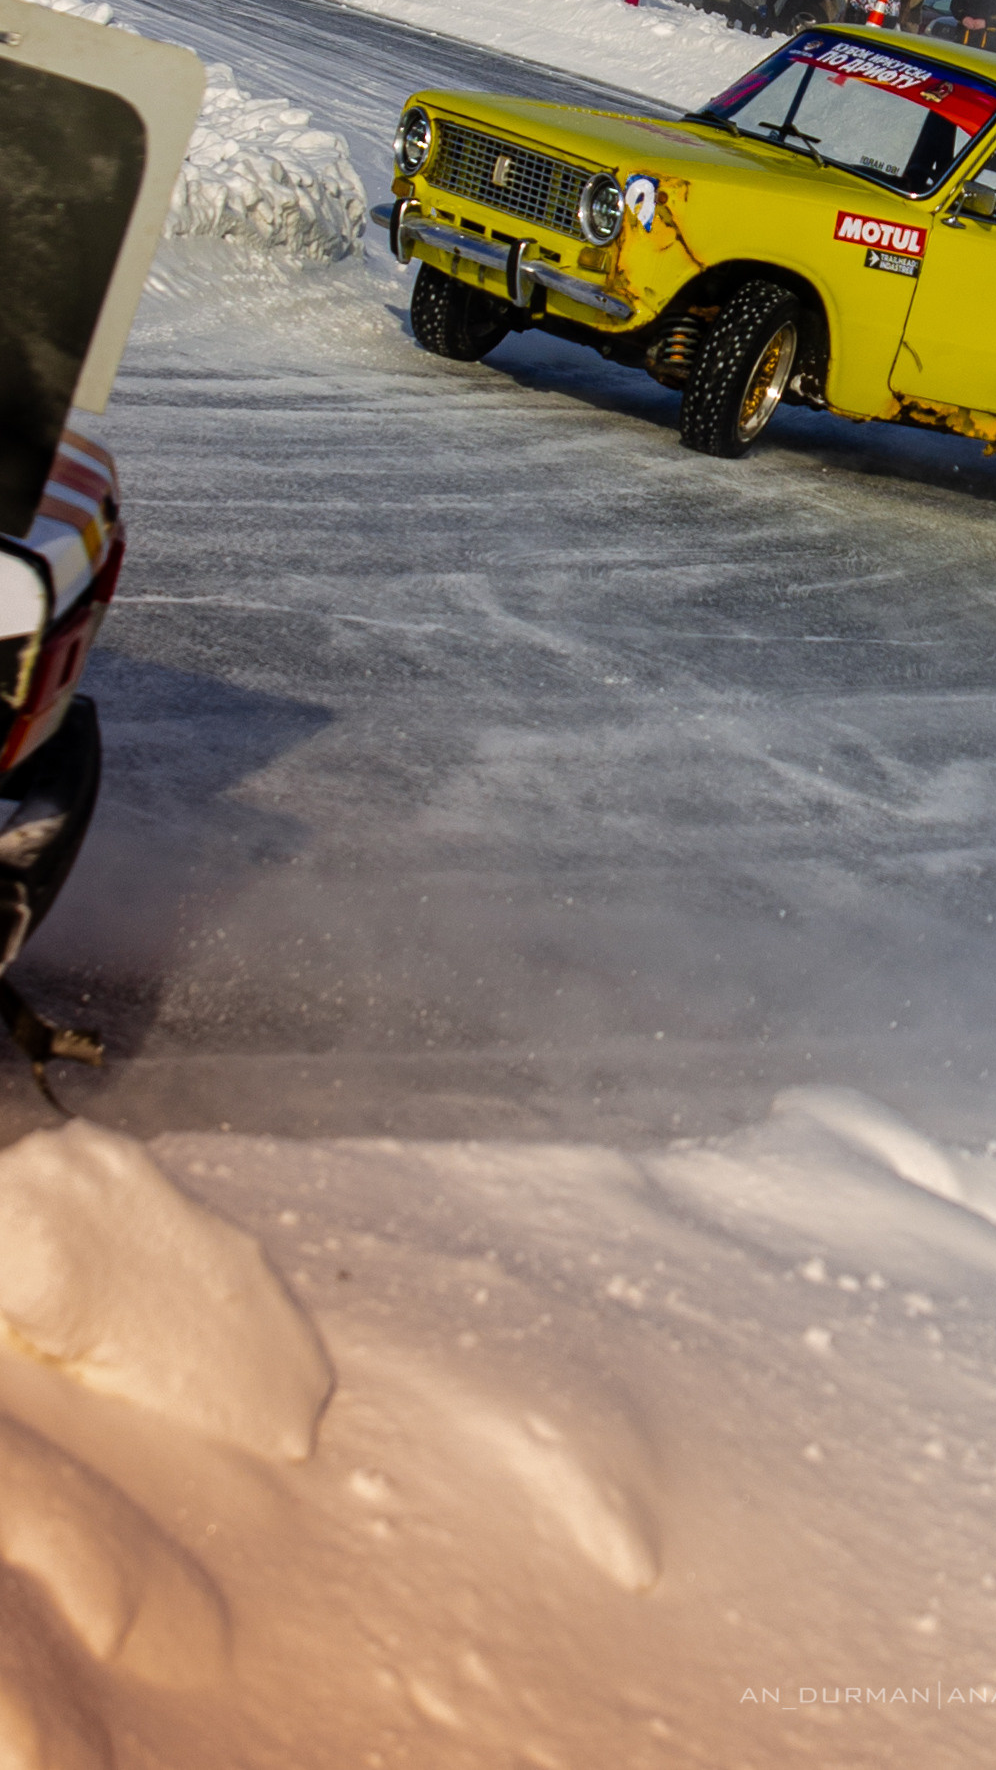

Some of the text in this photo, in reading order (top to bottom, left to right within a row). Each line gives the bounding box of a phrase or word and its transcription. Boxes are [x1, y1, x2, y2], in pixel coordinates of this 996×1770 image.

[816, 51, 849, 66] ПО
[838, 58, 922, 89] ДРИФТУ
[831, 42, 874, 59] КУБОК
[868, 53, 932, 81] ИРКУТСКА
[838, 215, 921, 253] MOTUL
